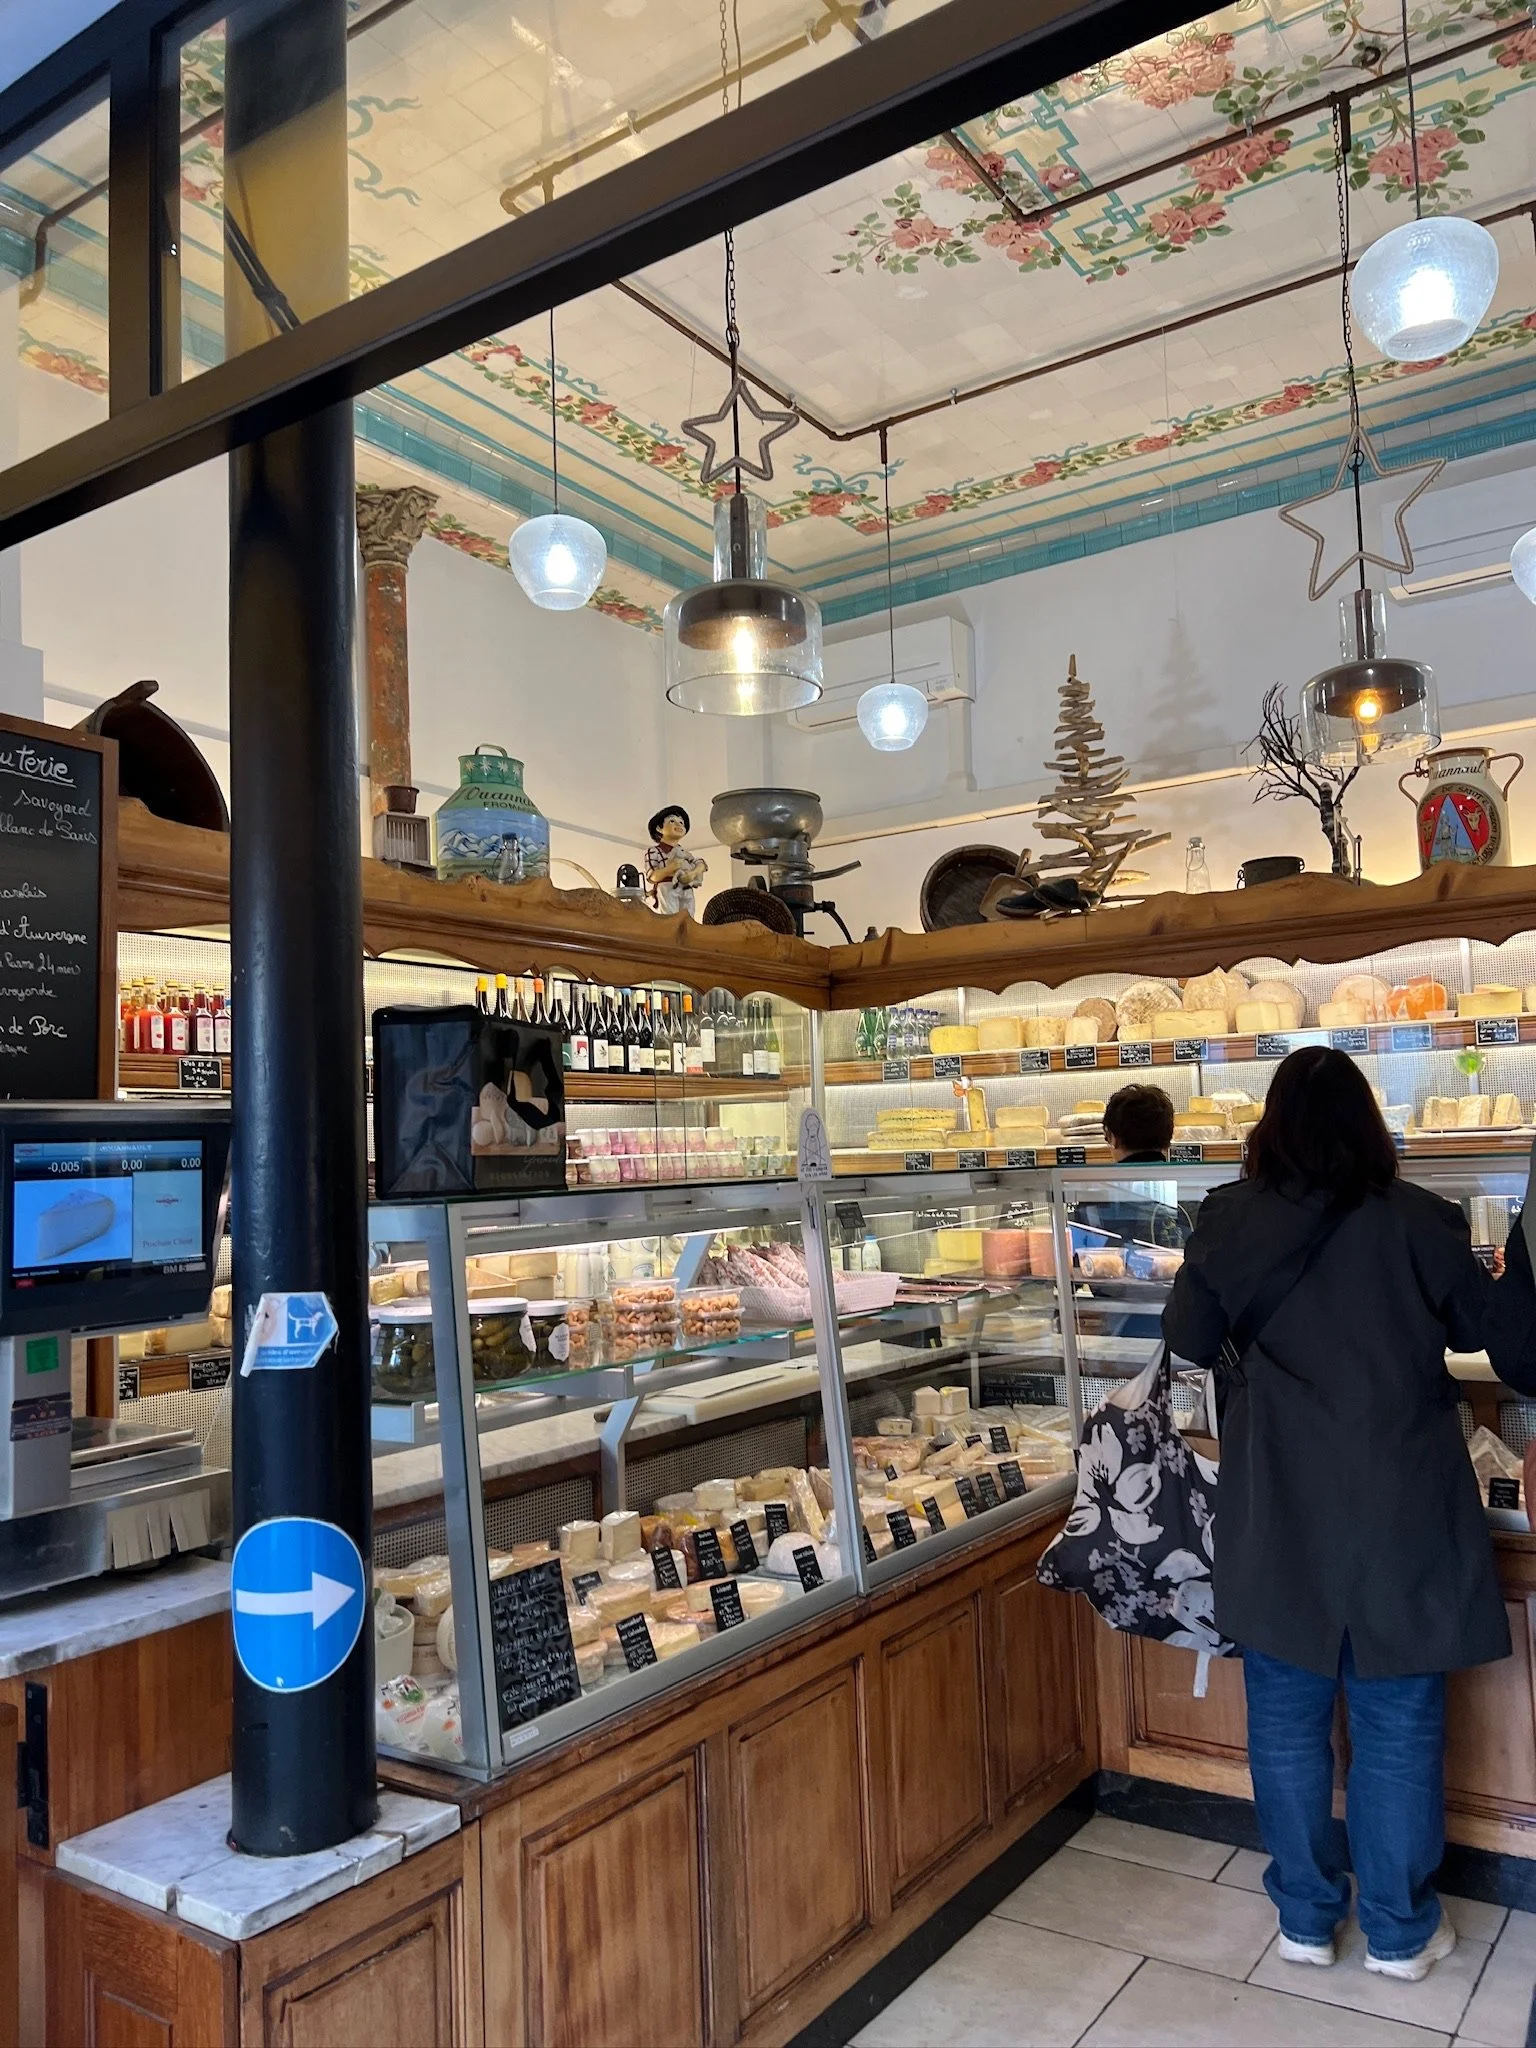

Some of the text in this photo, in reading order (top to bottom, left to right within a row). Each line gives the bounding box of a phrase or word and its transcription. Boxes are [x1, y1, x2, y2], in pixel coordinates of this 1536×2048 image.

[13, 789, 91, 820] savoyard
[38, 819, 54, 837] de
[55, 820, 98, 844] Paris
[37, 952, 55, 975] 24
[8, 1015, 67, 1038] de Porc
